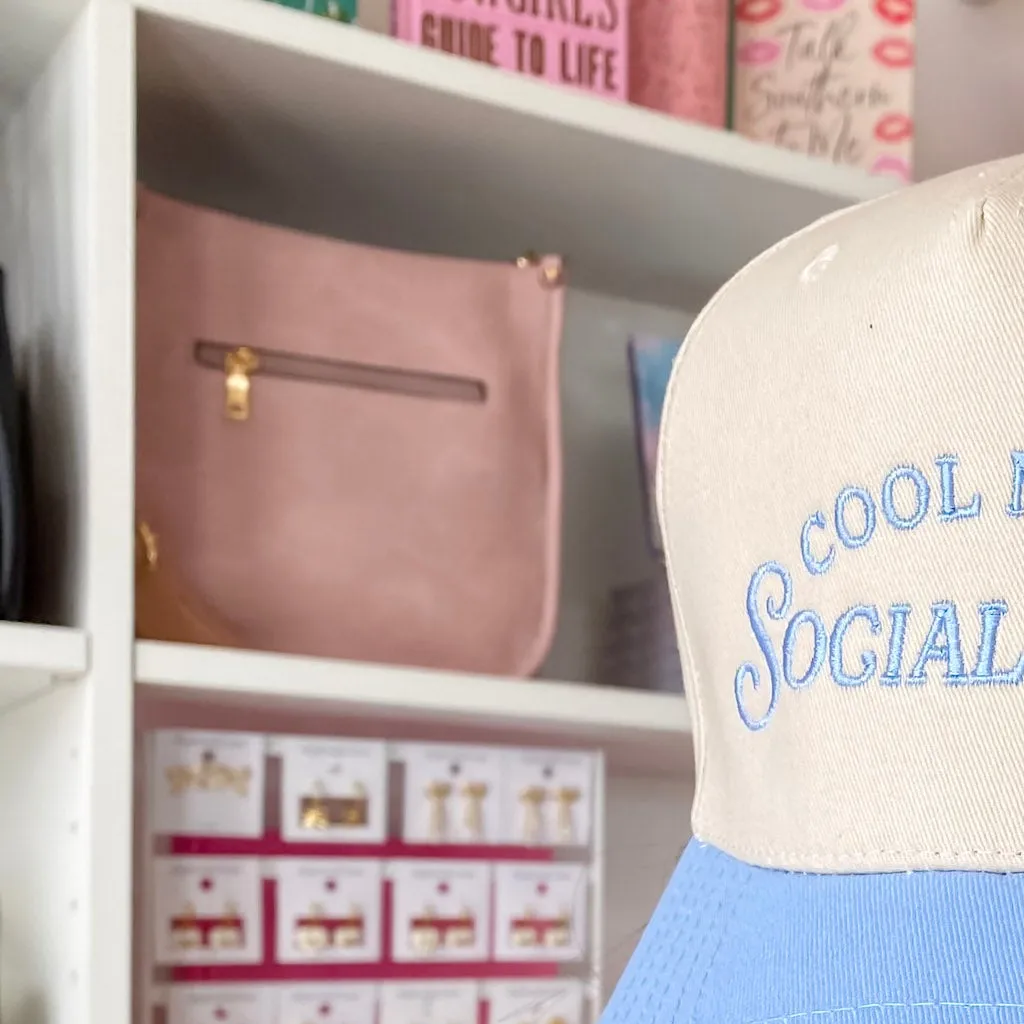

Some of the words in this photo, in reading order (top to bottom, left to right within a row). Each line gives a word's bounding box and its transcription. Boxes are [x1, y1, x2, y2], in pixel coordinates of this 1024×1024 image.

[420, 12, 500, 67] GUIDE
[514, 29, 545, 76] TO
[559, 38, 618, 92] LIFE
[799, 454, 983, 576] COOL
